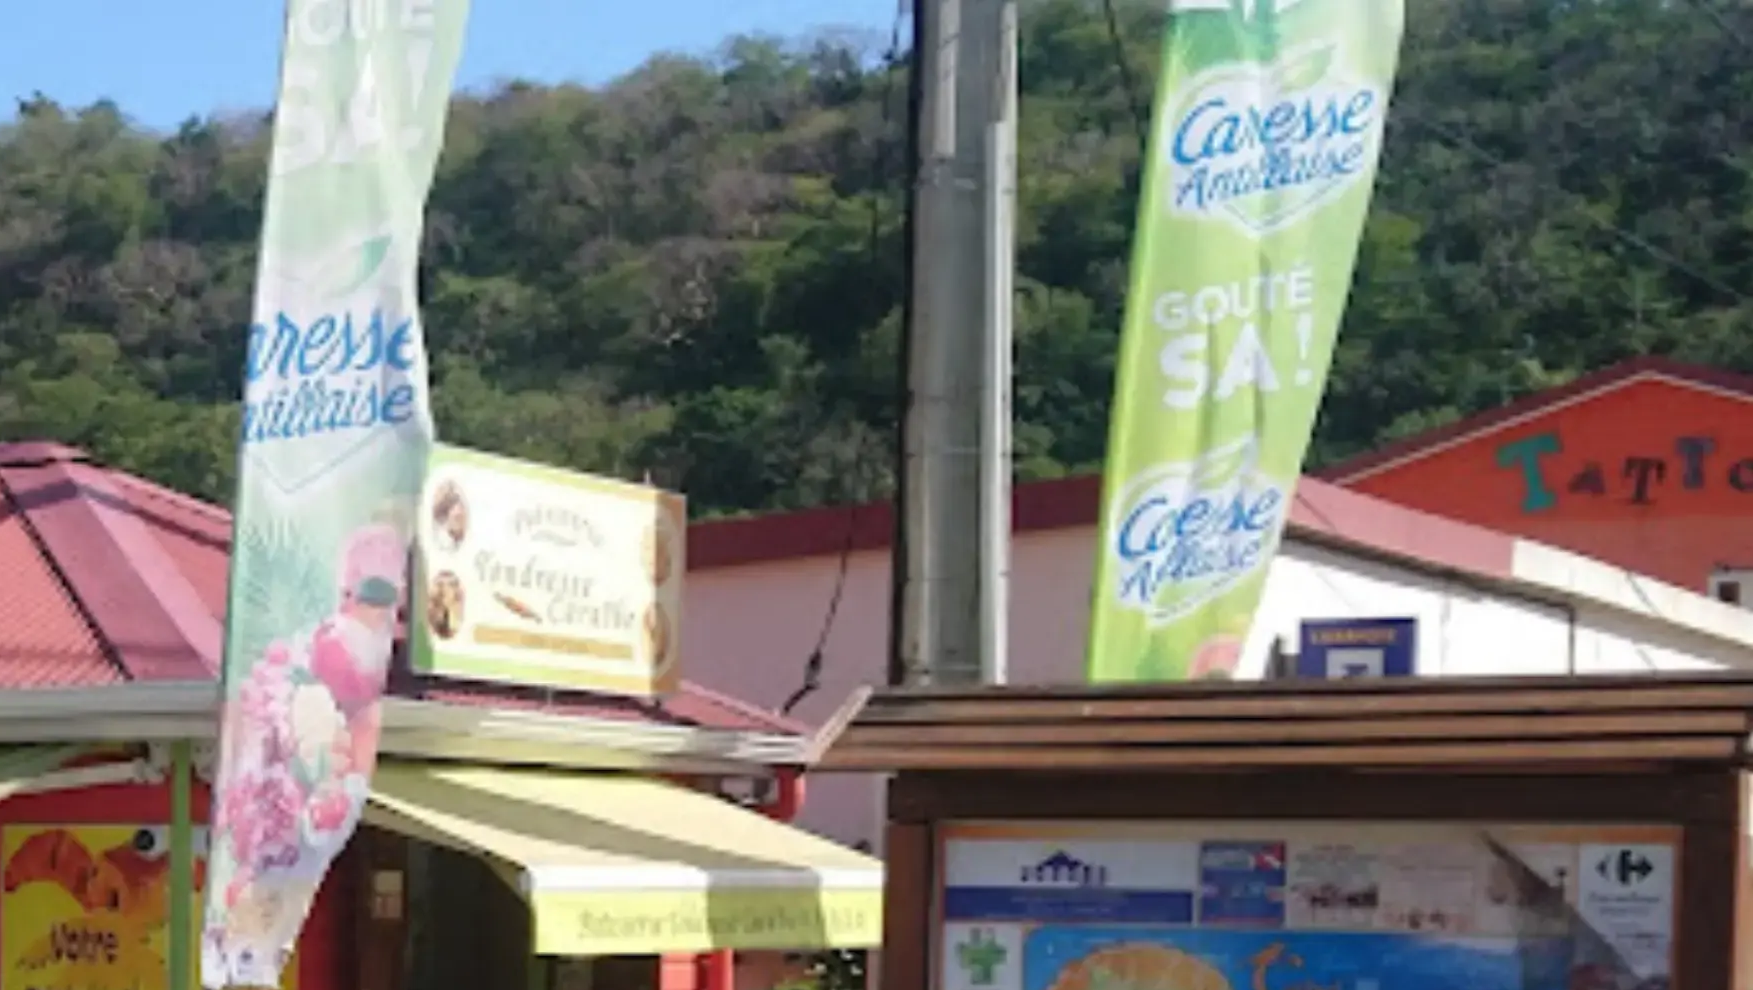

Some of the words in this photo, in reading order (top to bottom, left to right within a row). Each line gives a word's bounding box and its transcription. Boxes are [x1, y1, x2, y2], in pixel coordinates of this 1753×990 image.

[1171, 89, 1374, 165] Caresse
[246, 309, 414, 382] aresse
[51, 923, 117, 963] Votre
